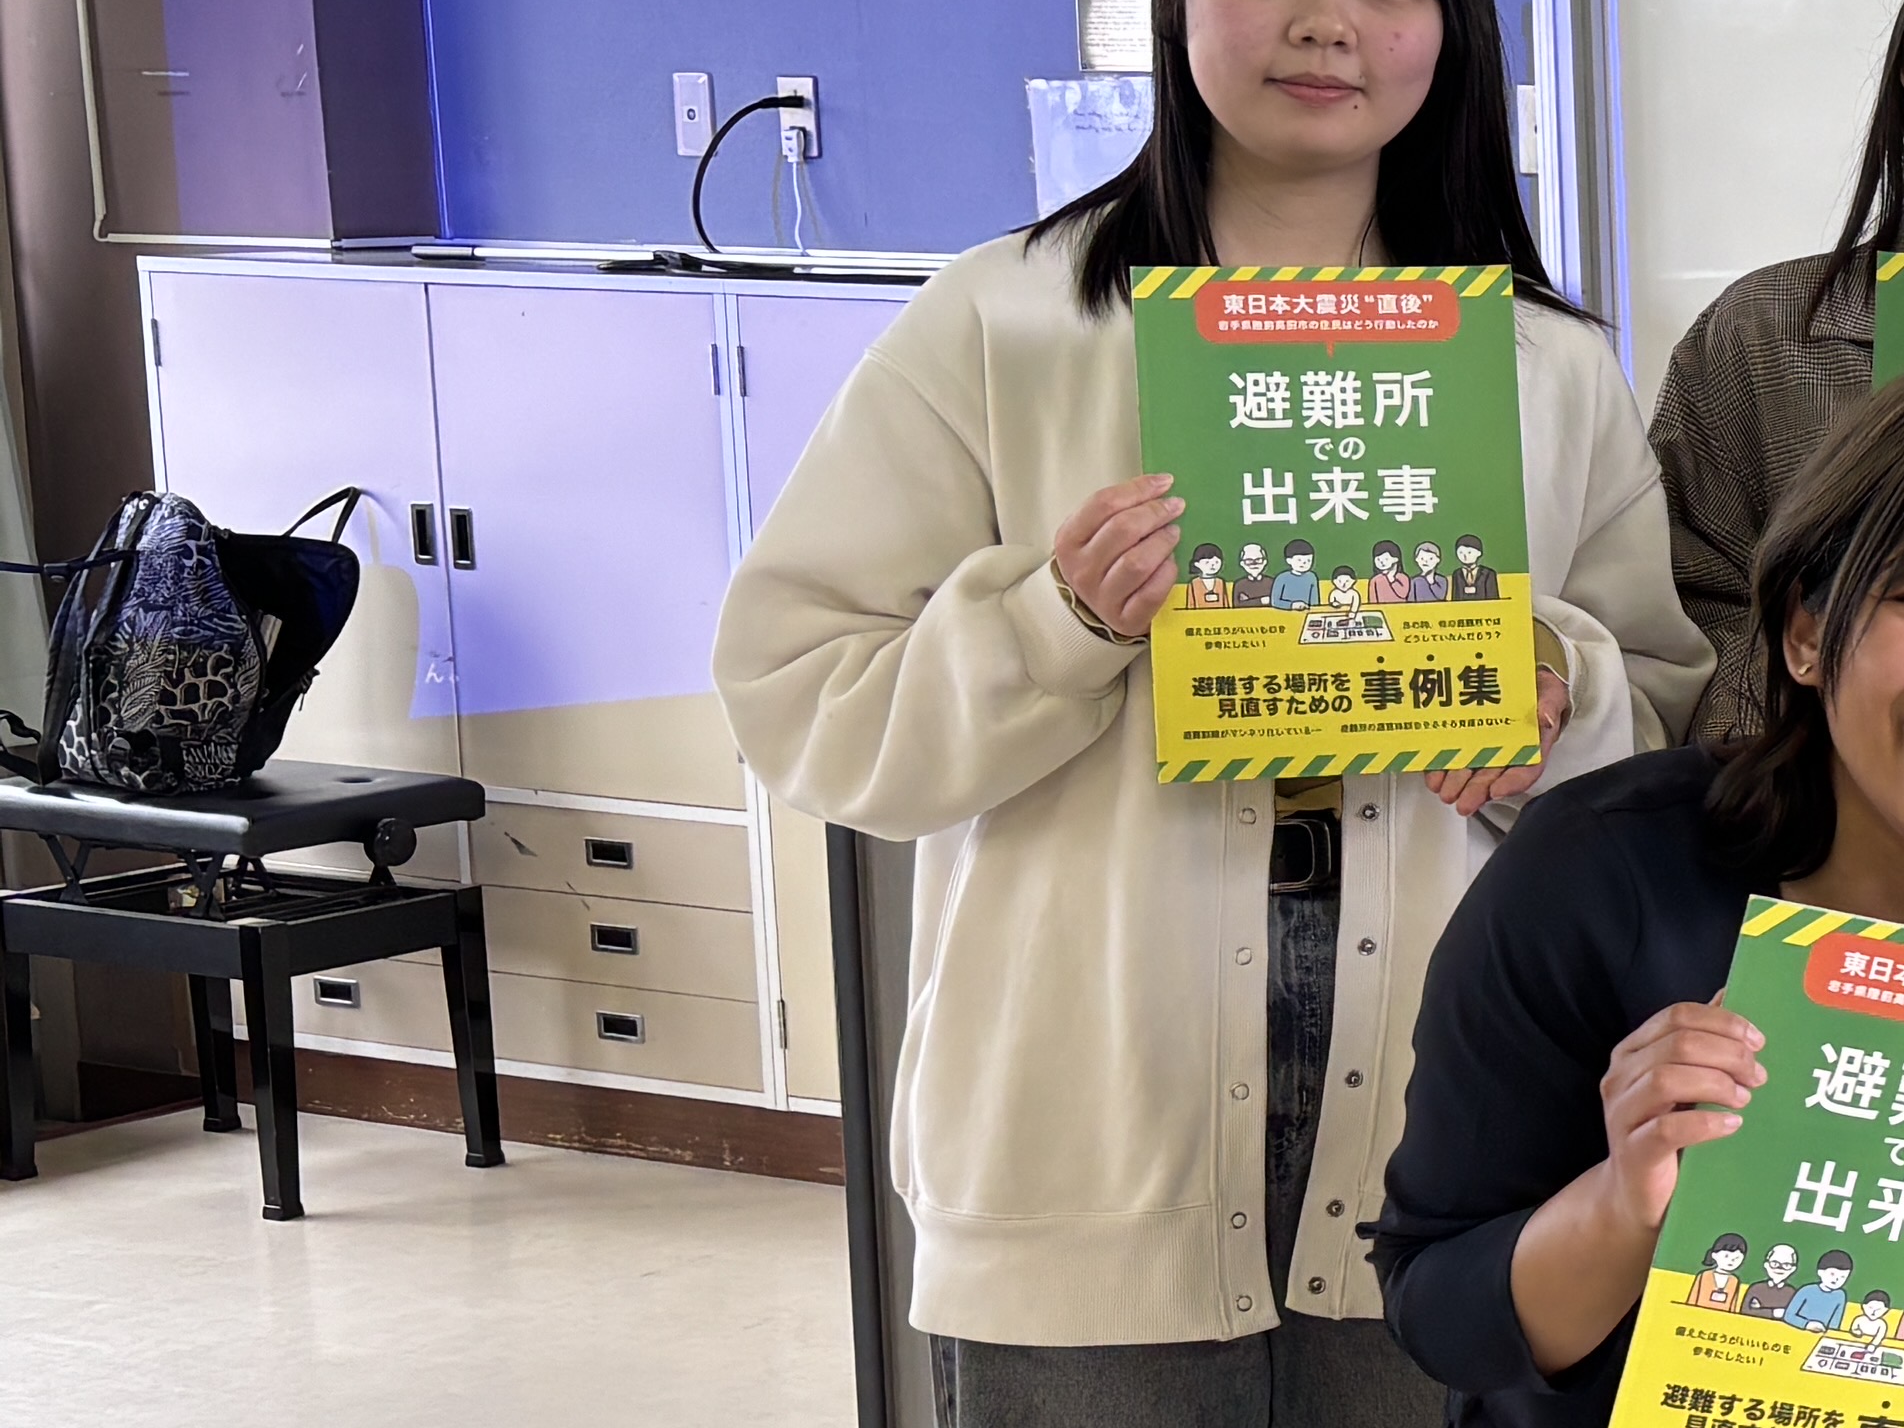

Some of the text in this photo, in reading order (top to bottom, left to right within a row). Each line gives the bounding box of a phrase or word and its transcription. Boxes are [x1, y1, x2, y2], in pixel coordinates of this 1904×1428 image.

[1222, 293, 1433, 315] 東日本大震災“直後”
[1228, 370, 1434, 429] 避難所
[1305, 436, 1366, 461] での
[1242, 464, 1439, 526] 出来事
[1191, 671, 1351, 698] 避難する場所を
[1359, 664, 1502, 711] 事例集
[1217, 694, 1353, 719] 見直すための
